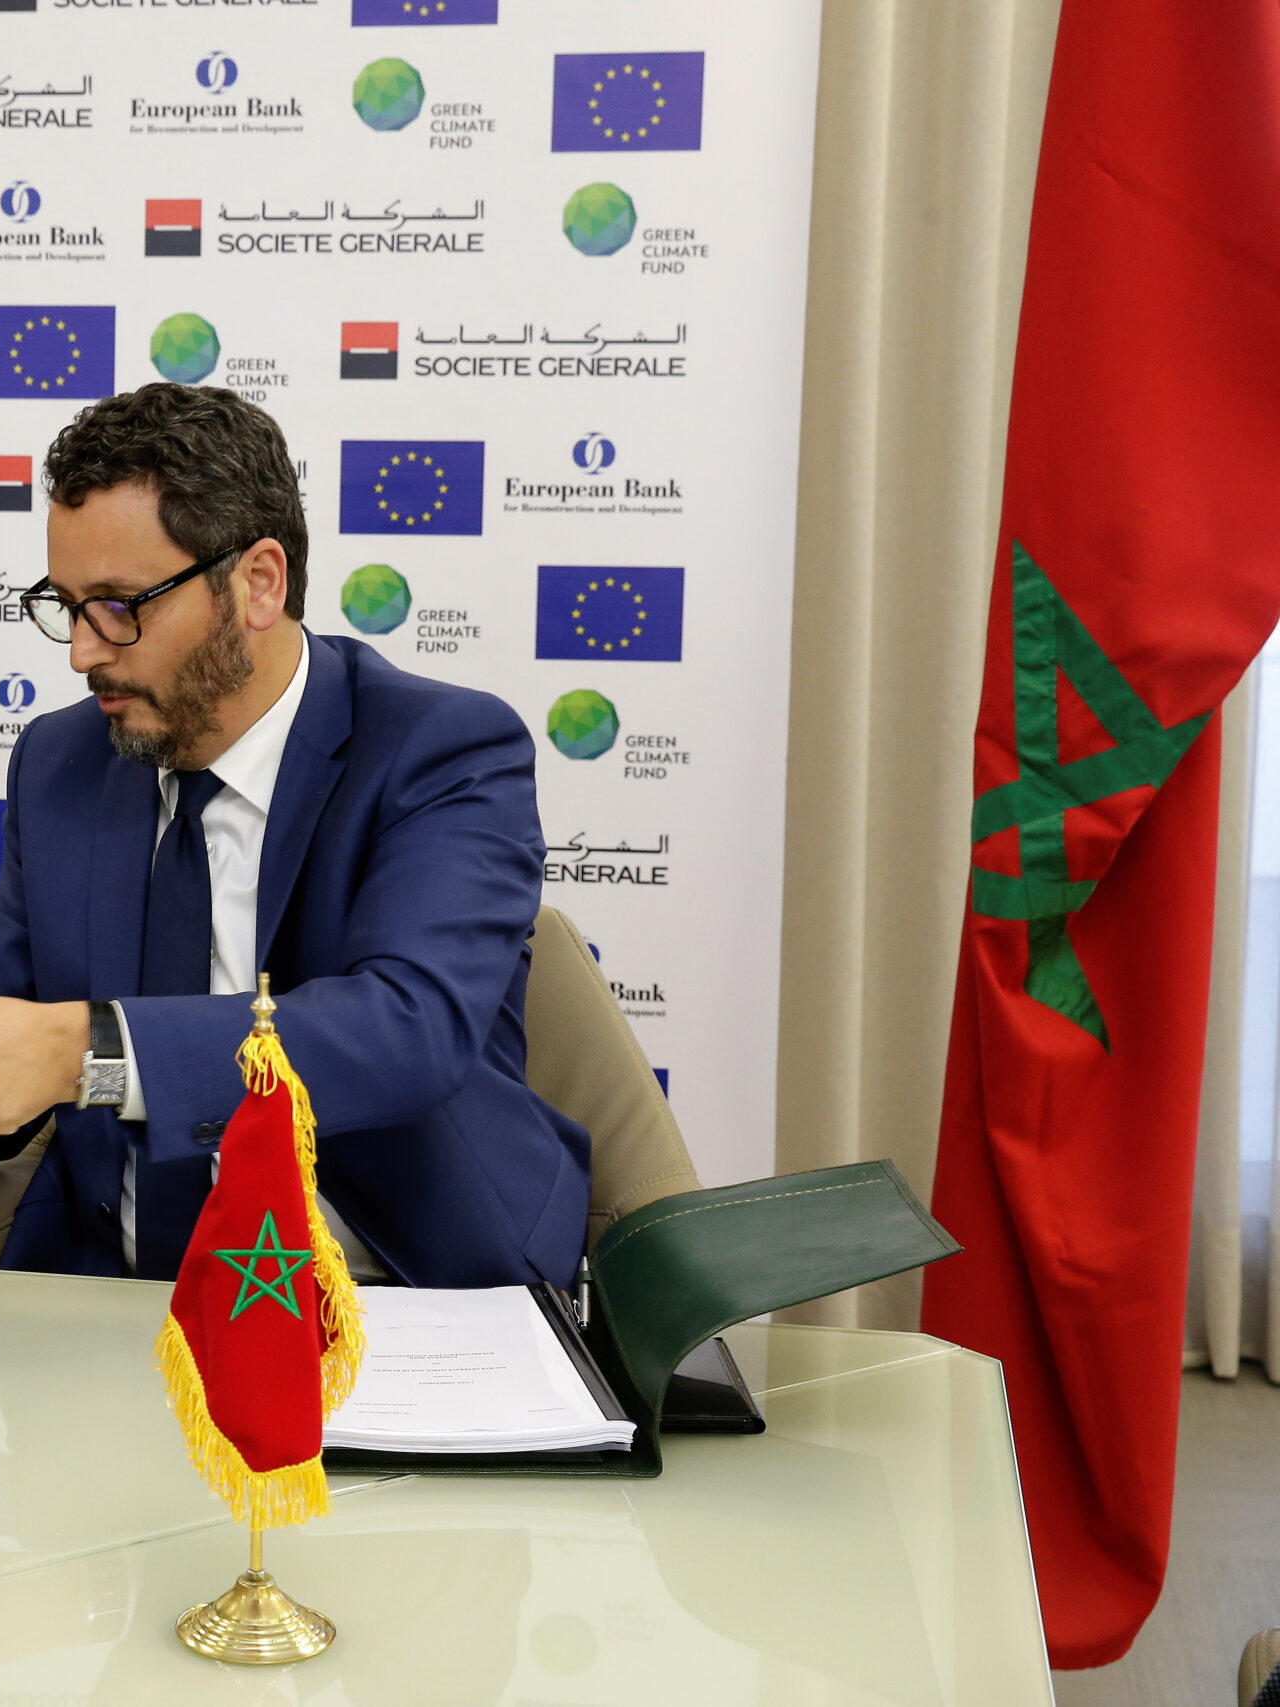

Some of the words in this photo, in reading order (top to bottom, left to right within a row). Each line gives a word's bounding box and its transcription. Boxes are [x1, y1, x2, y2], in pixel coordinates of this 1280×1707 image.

[131, 98, 236, 120] European
[248, 98, 302, 116] Bank
[431, 104, 482, 117] GREEN
[130, 124, 143, 133] for
[147, 124, 218, 133] Reconstruction
[221, 124, 239, 133] and
[242, 124, 303, 135] Development
[430, 120, 495, 133] CLIMATE
[430, 136, 472, 149] FUND
[51, 227, 103, 245] Bank
[643, 229, 695, 242] GREEN
[218, 234, 332, 253] SOCIETE
[340, 233, 483, 253] GENERALE
[25, 252, 42, 261] and
[45, 252, 105, 263] Development
[642, 245, 708, 258] CLIMATE
[641, 261, 685, 274] FUND
[226, 358, 275, 371] GREEN
[415, 357, 531, 376] SOCIETE
[538, 357, 685, 377] GENERALE
[226, 374, 289, 387] CLIMATE
[505, 478, 614, 502] European
[624, 479, 682, 498] Bank
[504, 504, 518, 513] for
[521, 504, 595, 513] Reconstruction
[598, 505, 616, 514] and
[619, 504, 683, 515] Development
[417, 610, 467, 622] GREEN
[417, 625, 481, 638] CLIMATE
[417, 641, 458, 653] FUND
[625, 735, 676, 748] GREEN
[625, 751, 689, 764] CLIMATE
[624, 767, 667, 779] FUND
[547, 831, 669, 862] الشرك
[544, 863, 668, 885] ENERALE
[610, 982, 665, 1002] Bank
